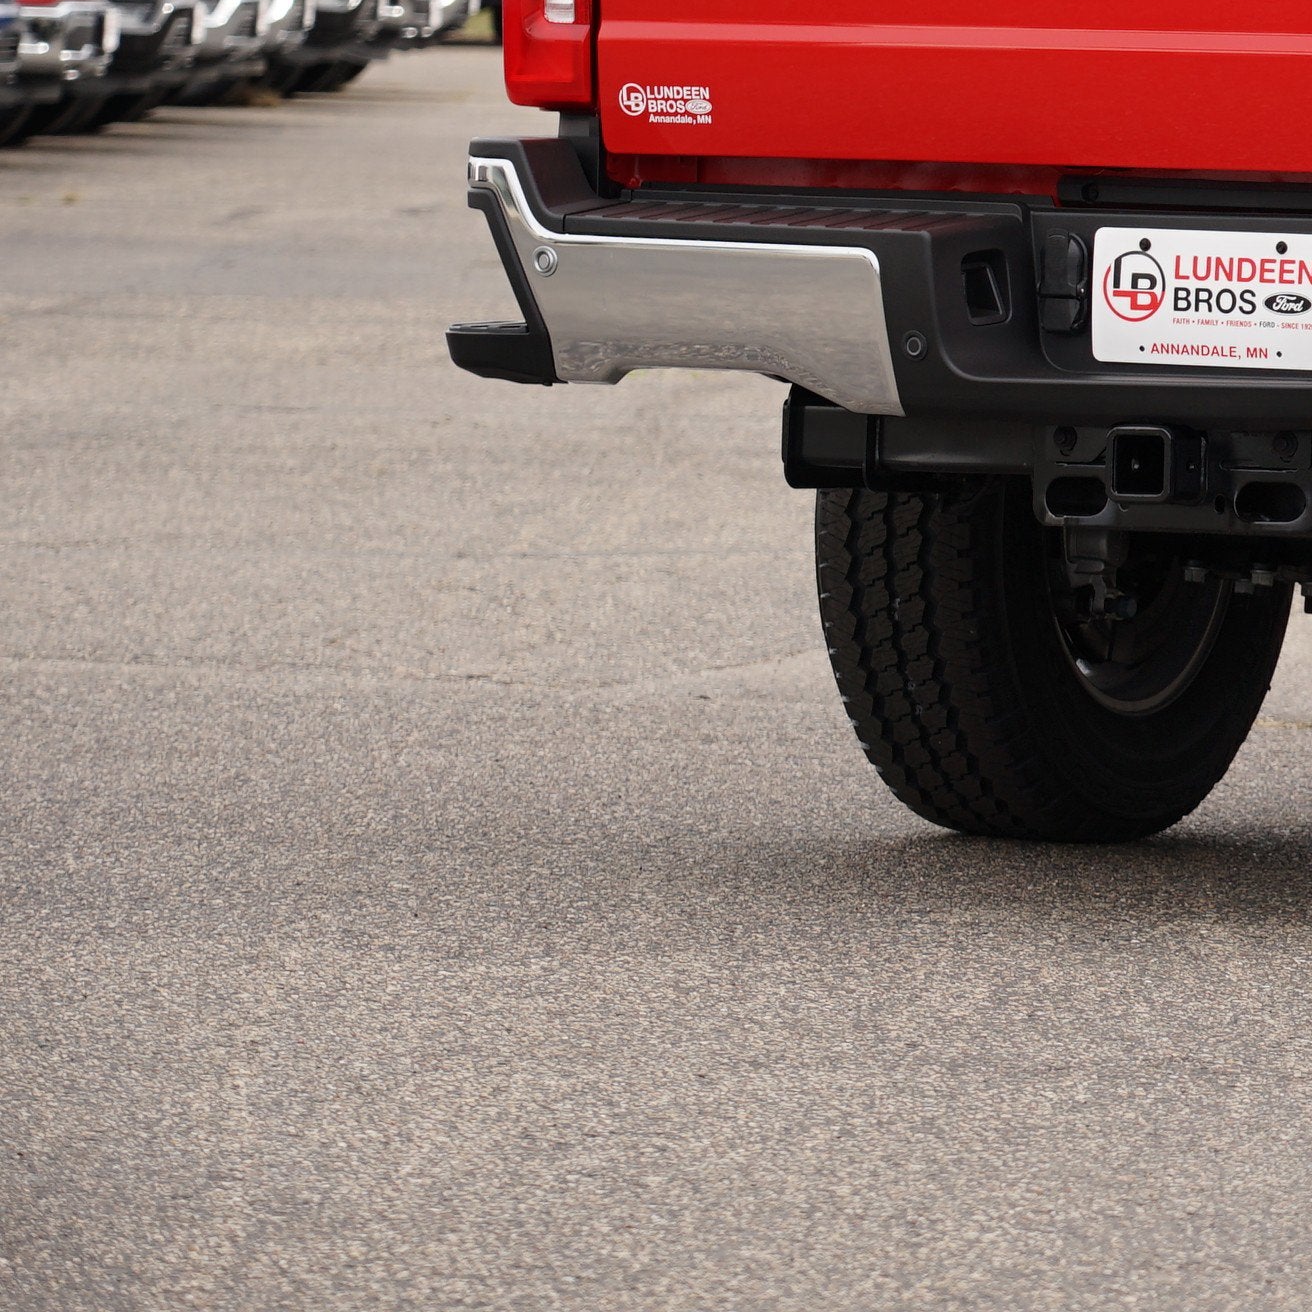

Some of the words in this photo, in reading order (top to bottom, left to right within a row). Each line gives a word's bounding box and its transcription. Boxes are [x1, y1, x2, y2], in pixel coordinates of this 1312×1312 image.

[646, 85, 710, 100] LUNDEEN
[647, 99, 686, 113] BROS
[649, 113, 696, 125] Annandale,
[697, 114, 712, 124] MN
[1173, 287, 1257, 315] BROS
[1173, 317, 1190, 325] FAITH
[1197, 319, 1219, 327] FAMILY
[1226, 320, 1252, 328] FRIENDS
[1281, 322, 1298, 330] SINCE
[1151, 343, 1241, 360] ANNANDALE,
[1246, 347, 1268, 359] MN
